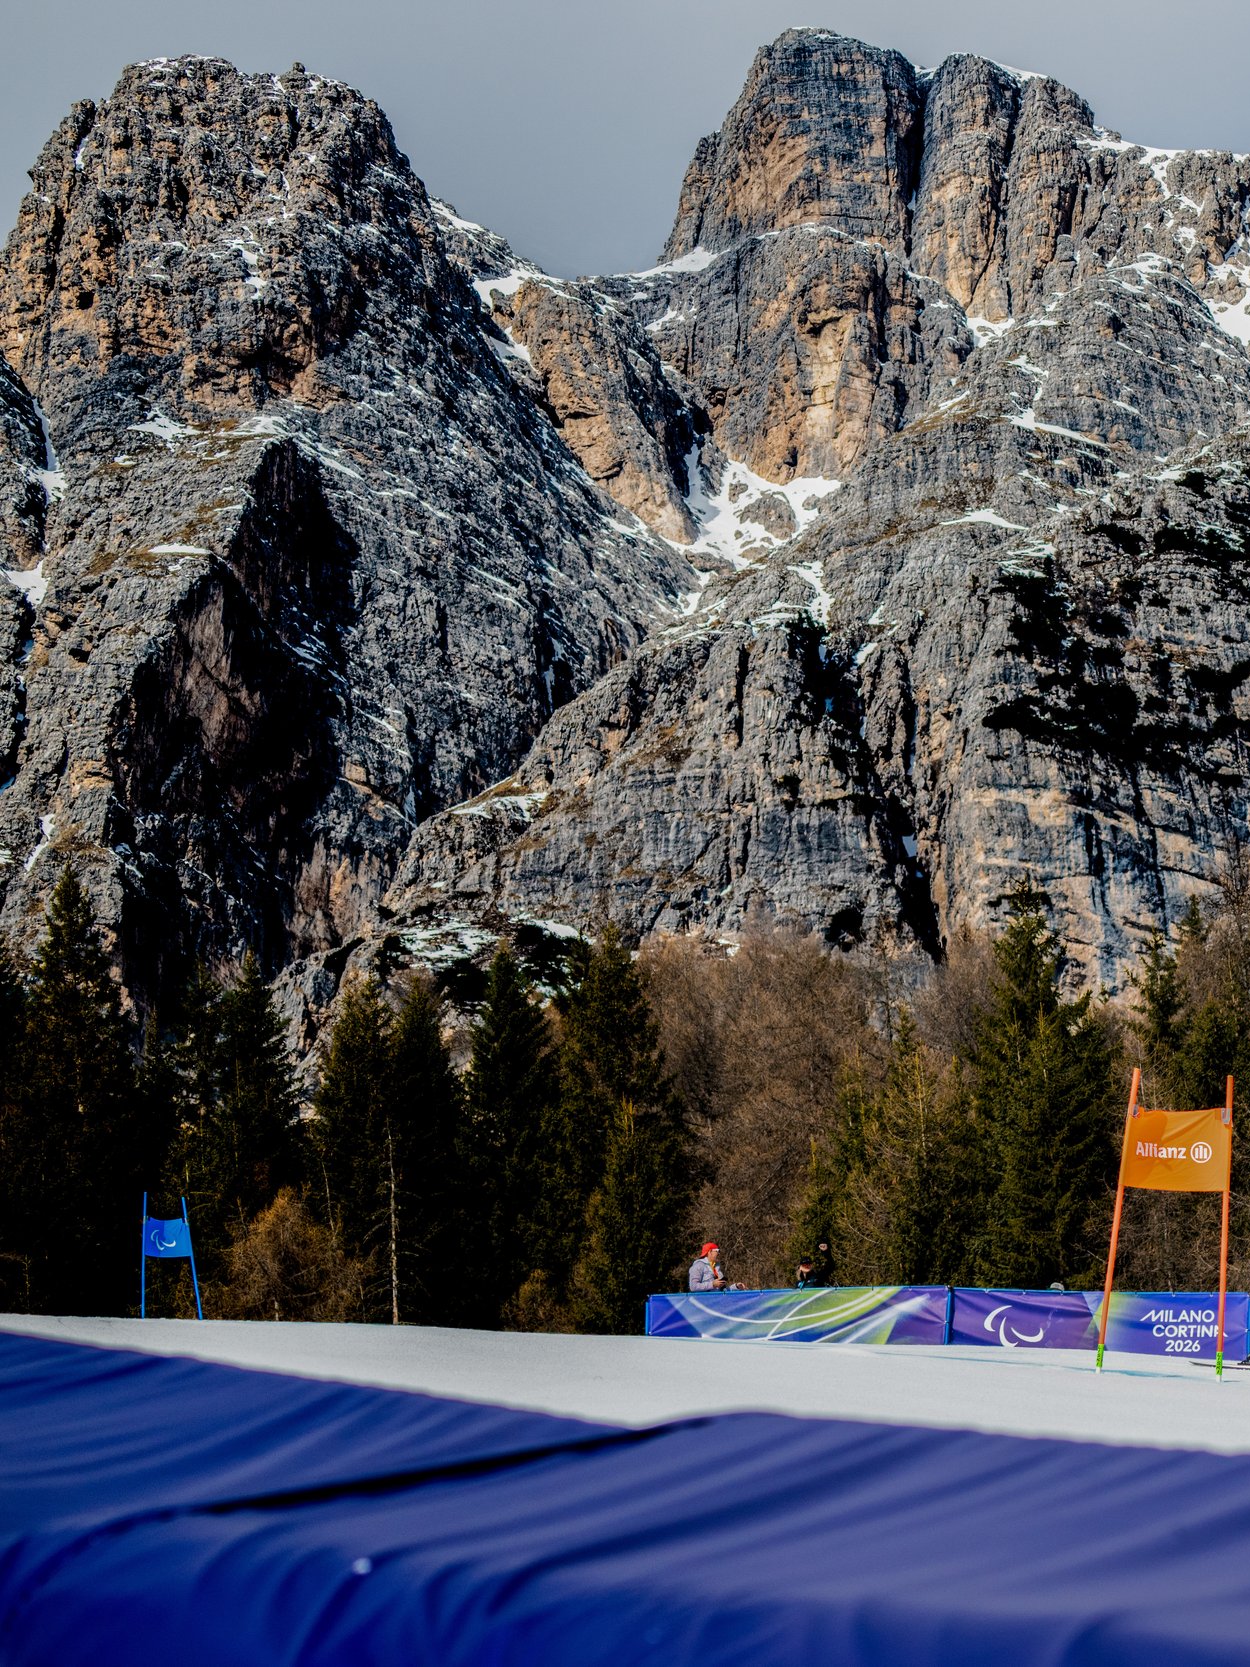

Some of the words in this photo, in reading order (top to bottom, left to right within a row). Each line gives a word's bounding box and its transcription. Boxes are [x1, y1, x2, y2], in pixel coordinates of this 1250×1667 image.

[1135, 1141, 1187, 1159] Allianz
[1139, 1309, 1215, 1323] MILANO
[1165, 1339, 1201, 1353] 2026
